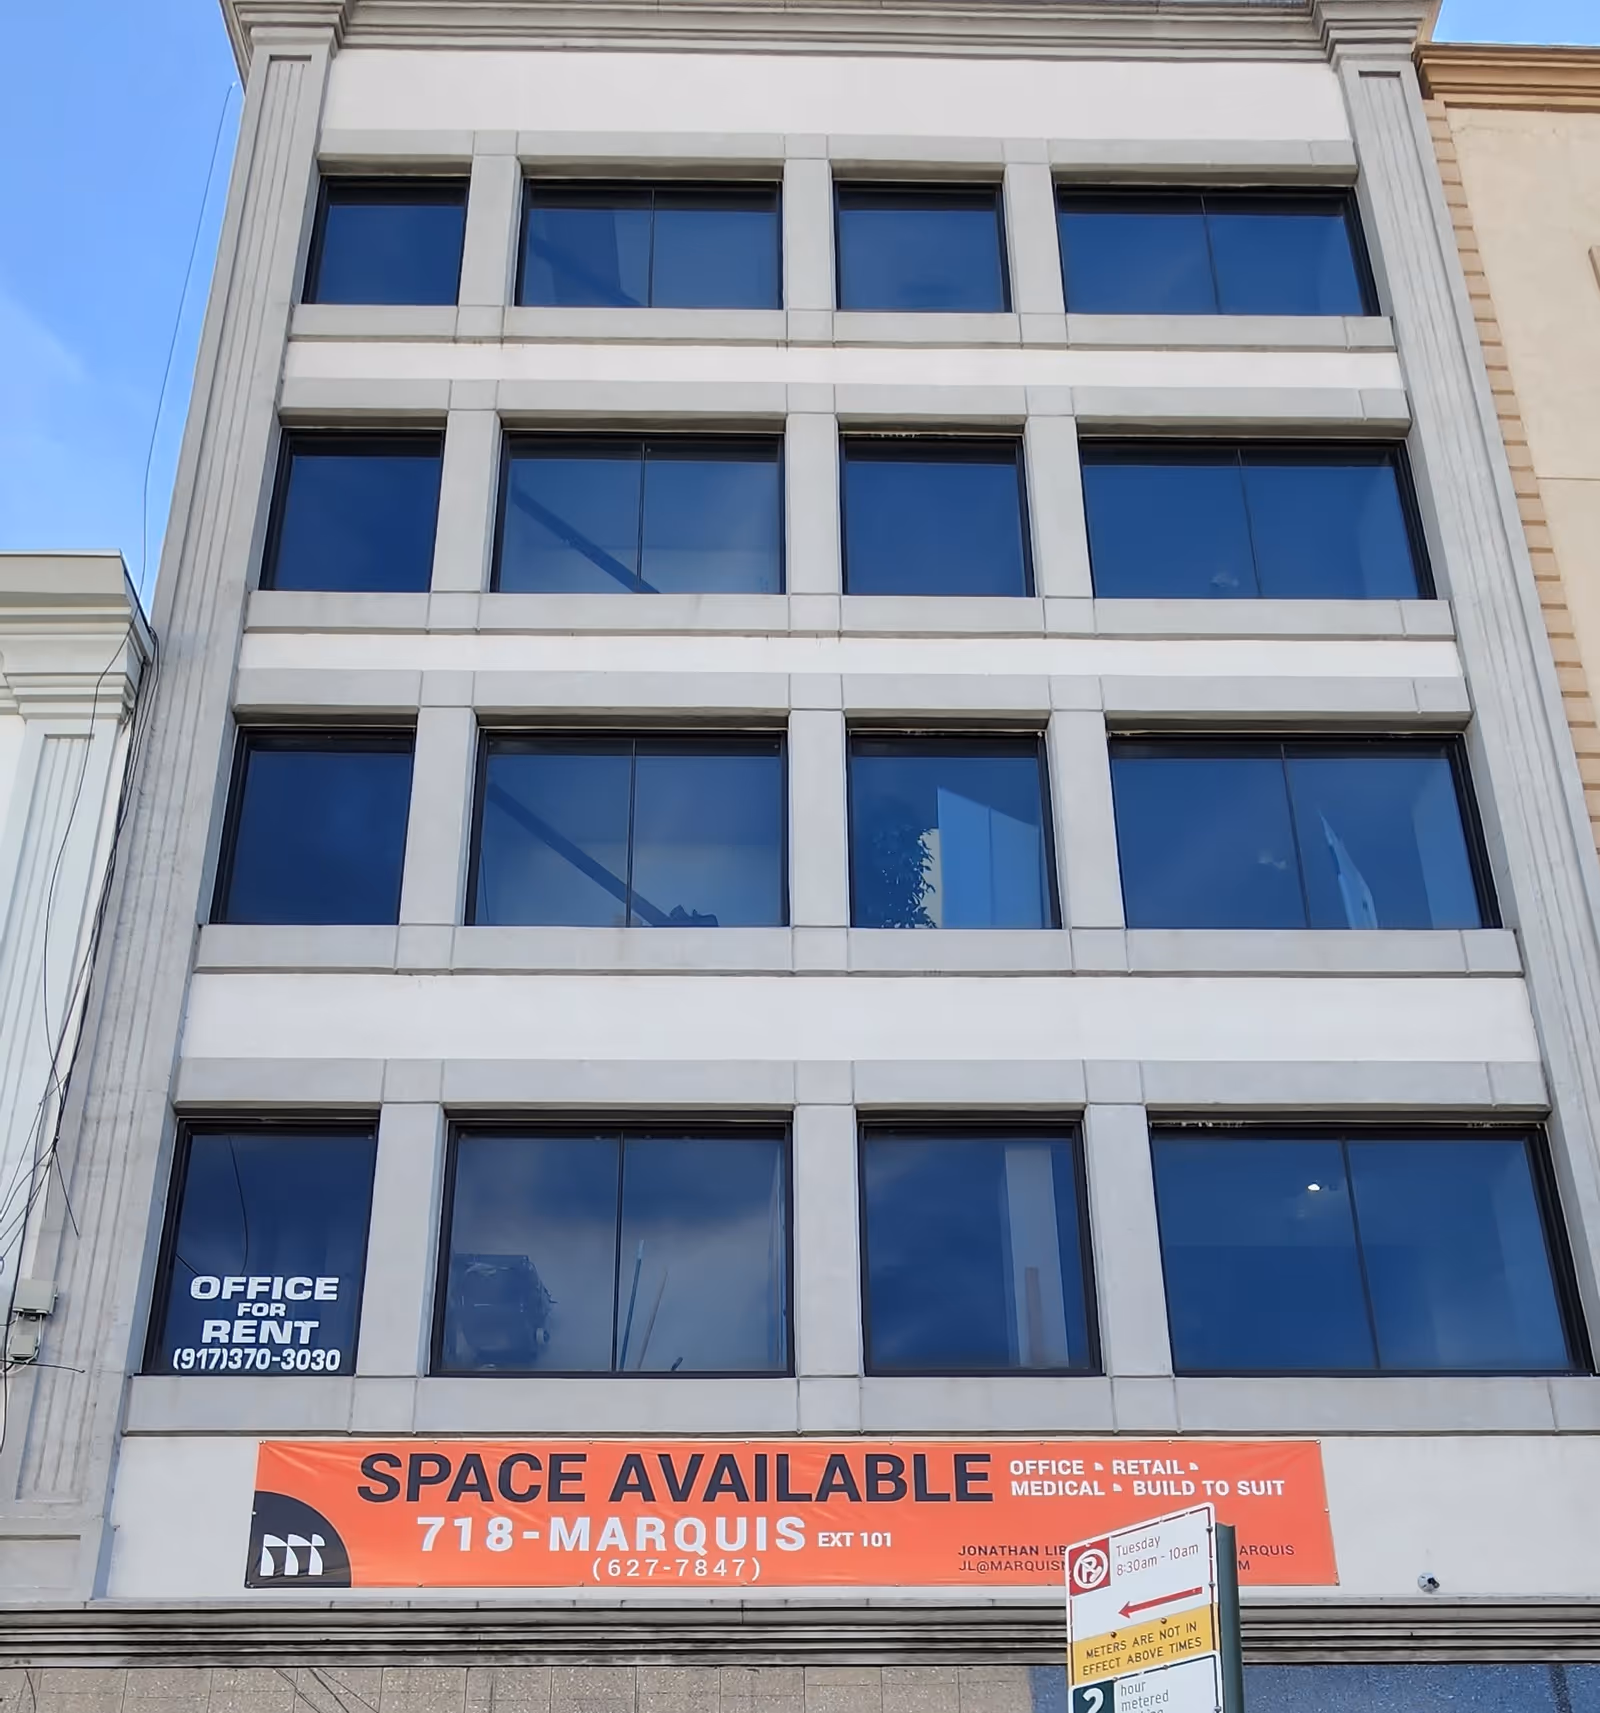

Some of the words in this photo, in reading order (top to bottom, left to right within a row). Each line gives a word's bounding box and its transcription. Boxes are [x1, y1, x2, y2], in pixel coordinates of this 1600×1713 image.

[190, 1275, 339, 1300] OFFICE
[237, 1302, 286, 1316] FOR
[202, 1319, 319, 1344] RENT
[173, 1348, 341, 1371] (917)370-3030
[356, 1453, 588, 1503] SPACE
[609, 1452, 994, 1503] AVAILABLE
[1010, 1459, 1084, 1476] OFFICE
[1112, 1459, 1185, 1475] RETAIL
[1011, 1480, 1105, 1497] MEDICAL
[1133, 1480, 1196, 1496] BUILD
[1202, 1480, 1231, 1496] TO
[1237, 1480, 1285, 1496] SUIT
[417, 1516, 806, 1555] 718-MARQUIS
[818, 1532, 854, 1548] EXT
[860, 1532, 893, 1547] 101
[1116, 1535, 1160, 1557] Tuesday
[958, 1545, 1039, 1556] JONATHAN
[1239, 1545, 1295, 1555] ARQUIS
[1116, 1555, 1158, 1576] 8:30am
[1169, 1543, 1199, 1561] 10am
[592, 1557, 762, 1580] (627-7847)
[1086, 1640, 1127, 1659] METERS
[1132, 1633, 1155, 1648] ARE
[1159, 1627, 1181, 1640] NOT
[1186, 1621, 1197, 1632] IN
[1083, 1659, 1121, 1676] EFFECT
[1127, 1646, 1164, 1664] ABOVE
[1170, 1637, 1202, 1653] TIMES
[1121, 1681, 1146, 1696] hour
[1121, 1690, 1169, 1712] metered
